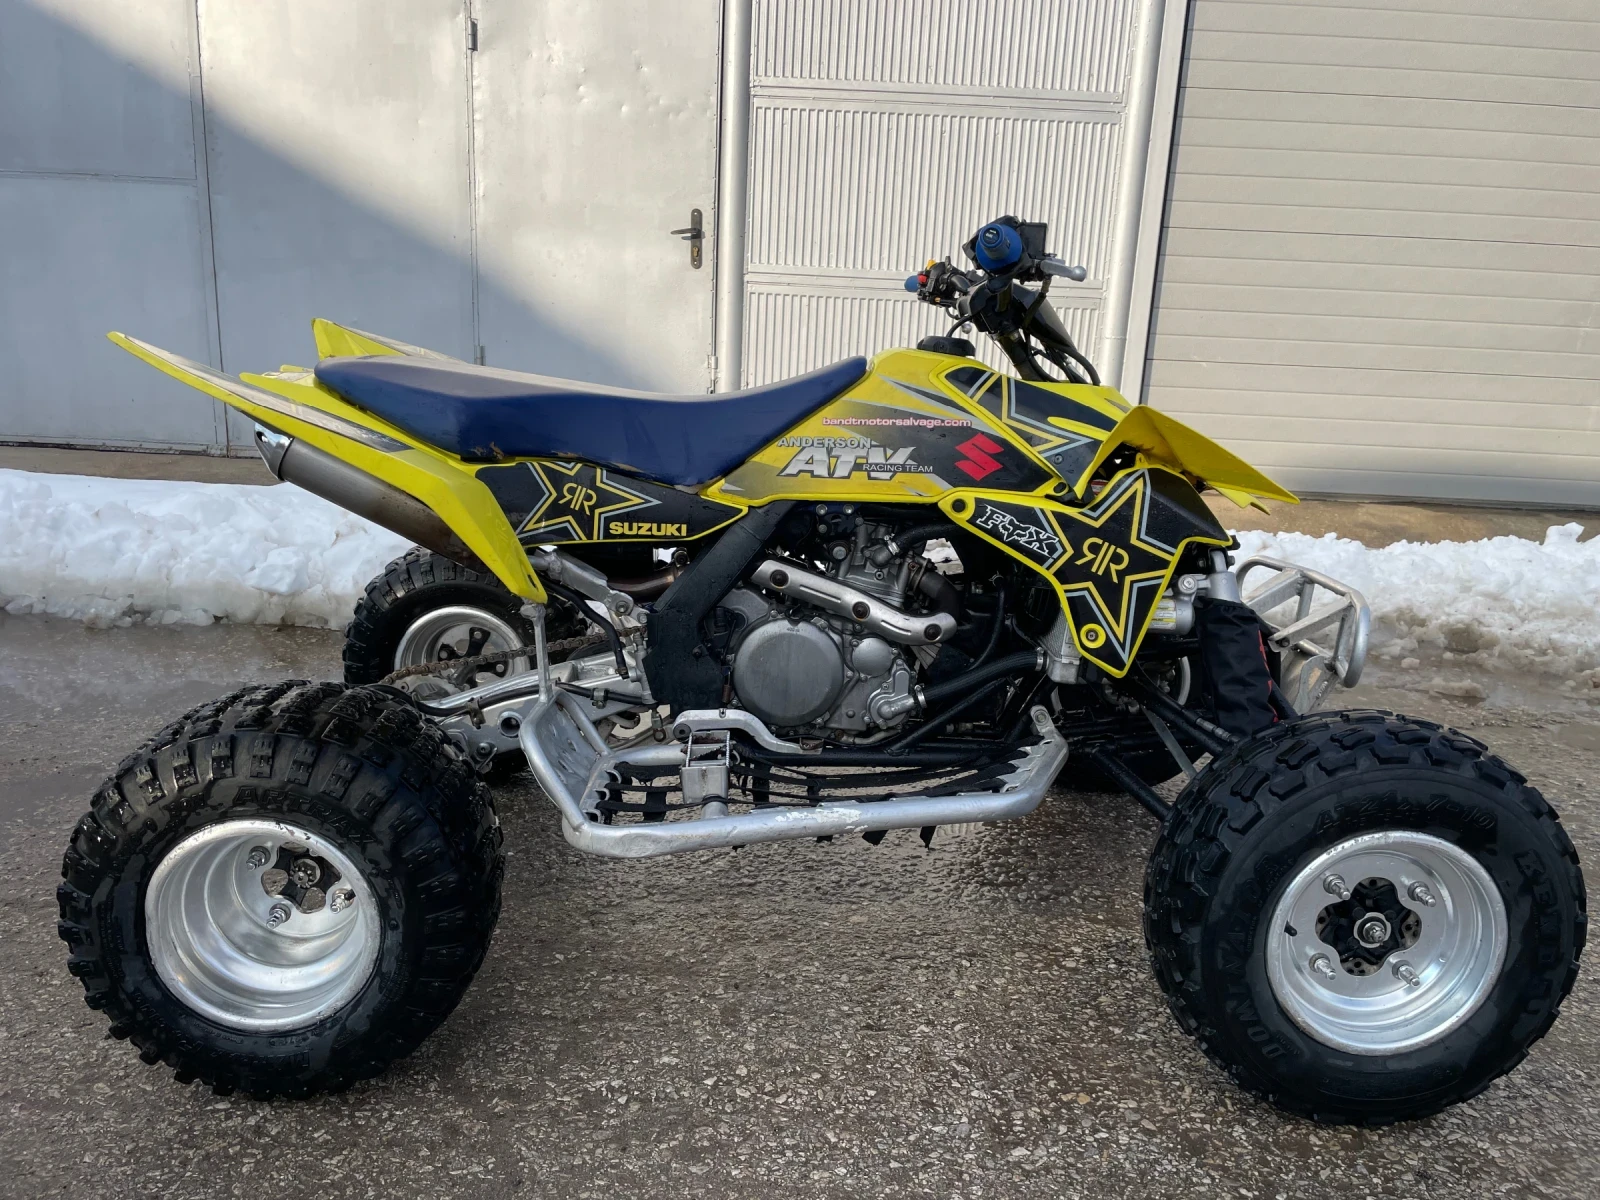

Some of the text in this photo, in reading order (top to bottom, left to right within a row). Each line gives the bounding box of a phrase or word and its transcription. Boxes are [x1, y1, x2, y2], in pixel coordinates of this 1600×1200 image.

[822, 417, 973, 428] bandtmotorsalvage.com
[778, 437, 872, 449] ANDERSON
[776, 446, 916, 481] ATV
[863, 463, 933, 473] RACING TEAM
[609, 522, 687, 537] SUZUKI
